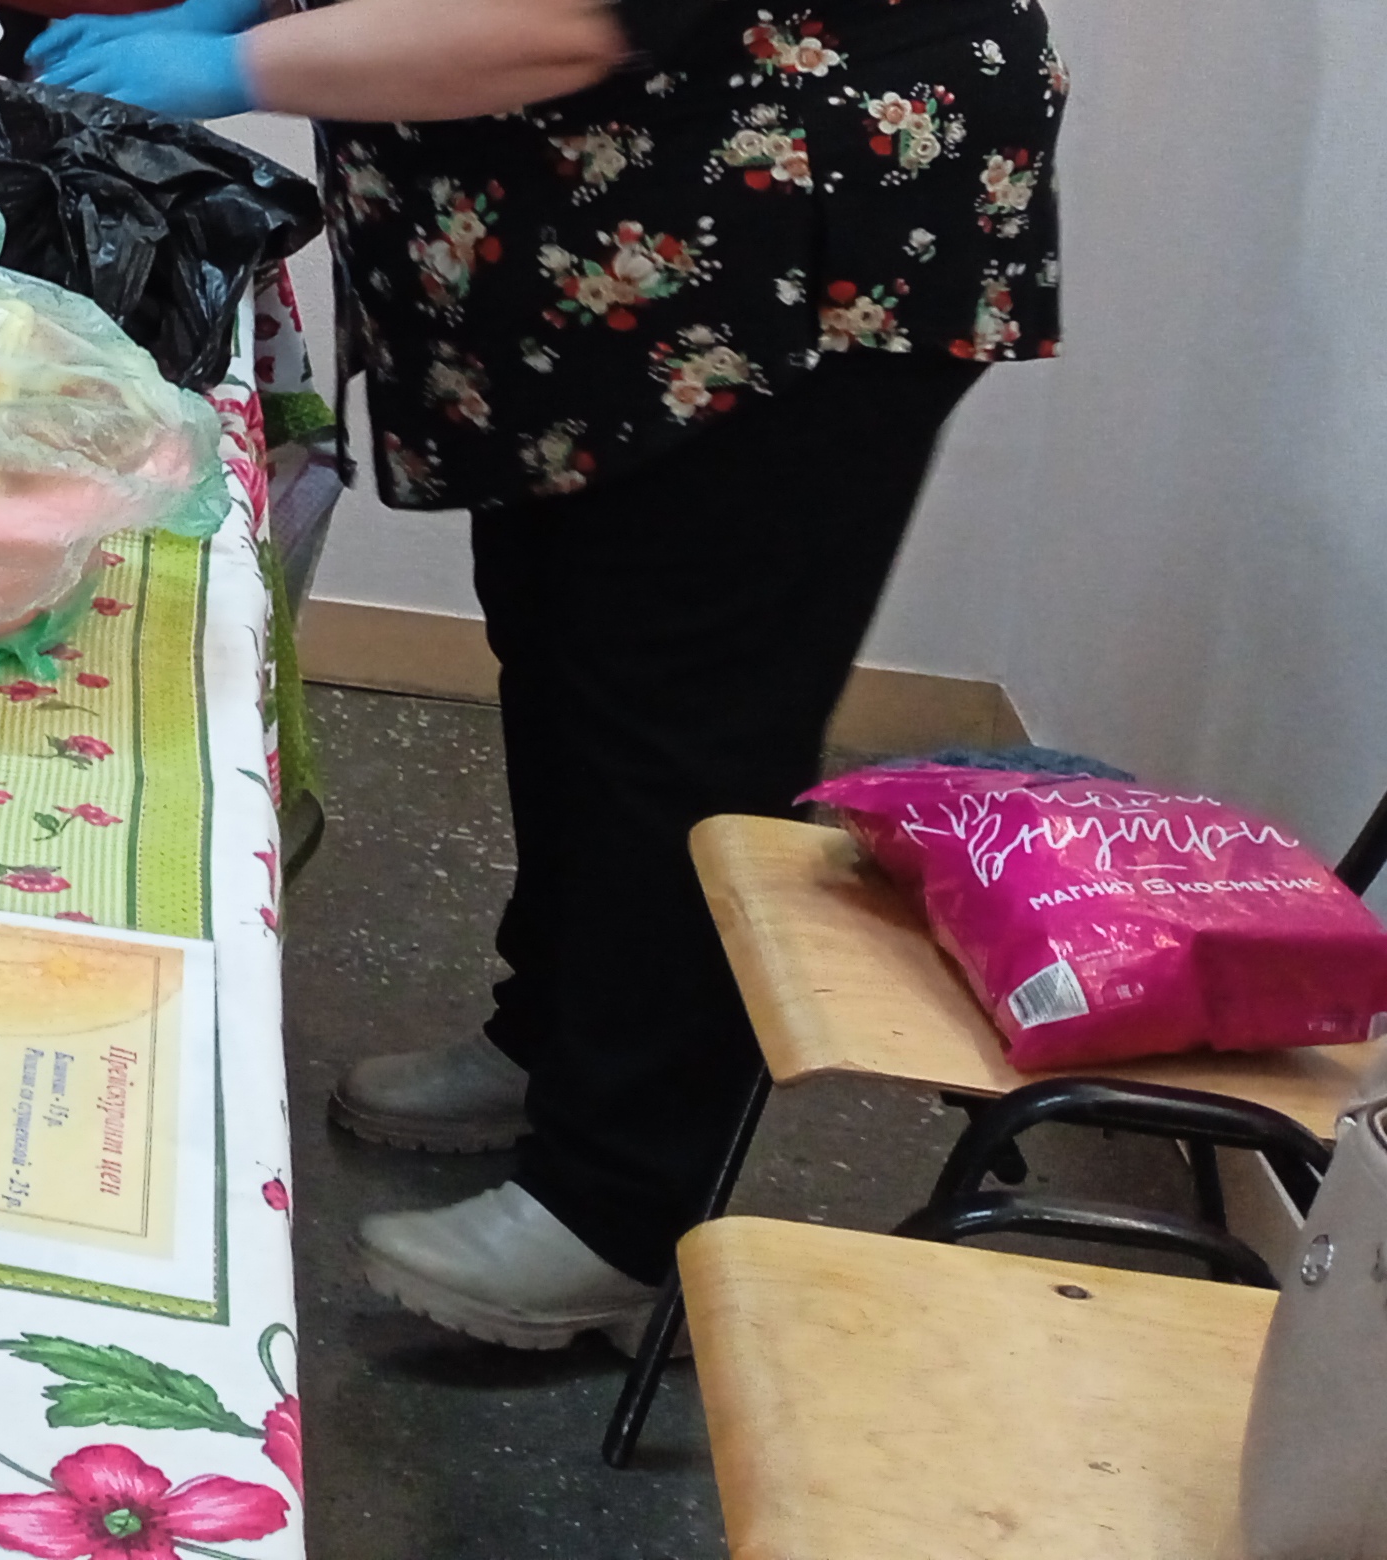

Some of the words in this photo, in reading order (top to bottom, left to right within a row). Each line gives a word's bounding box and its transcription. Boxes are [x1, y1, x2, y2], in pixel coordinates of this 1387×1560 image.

[1028, 880, 1136, 911] МАГНИТ
[1175, 877, 1321, 895] КОСМЕТИК
[49, 1103, 70, 1119] 15
[97, 1046, 137, 1154] Прейскурант
[12, 1101, 32, 1167] сгущенкой
[8, 1177, 31, 1197] 25
[96, 1158, 122, 1196] цен
